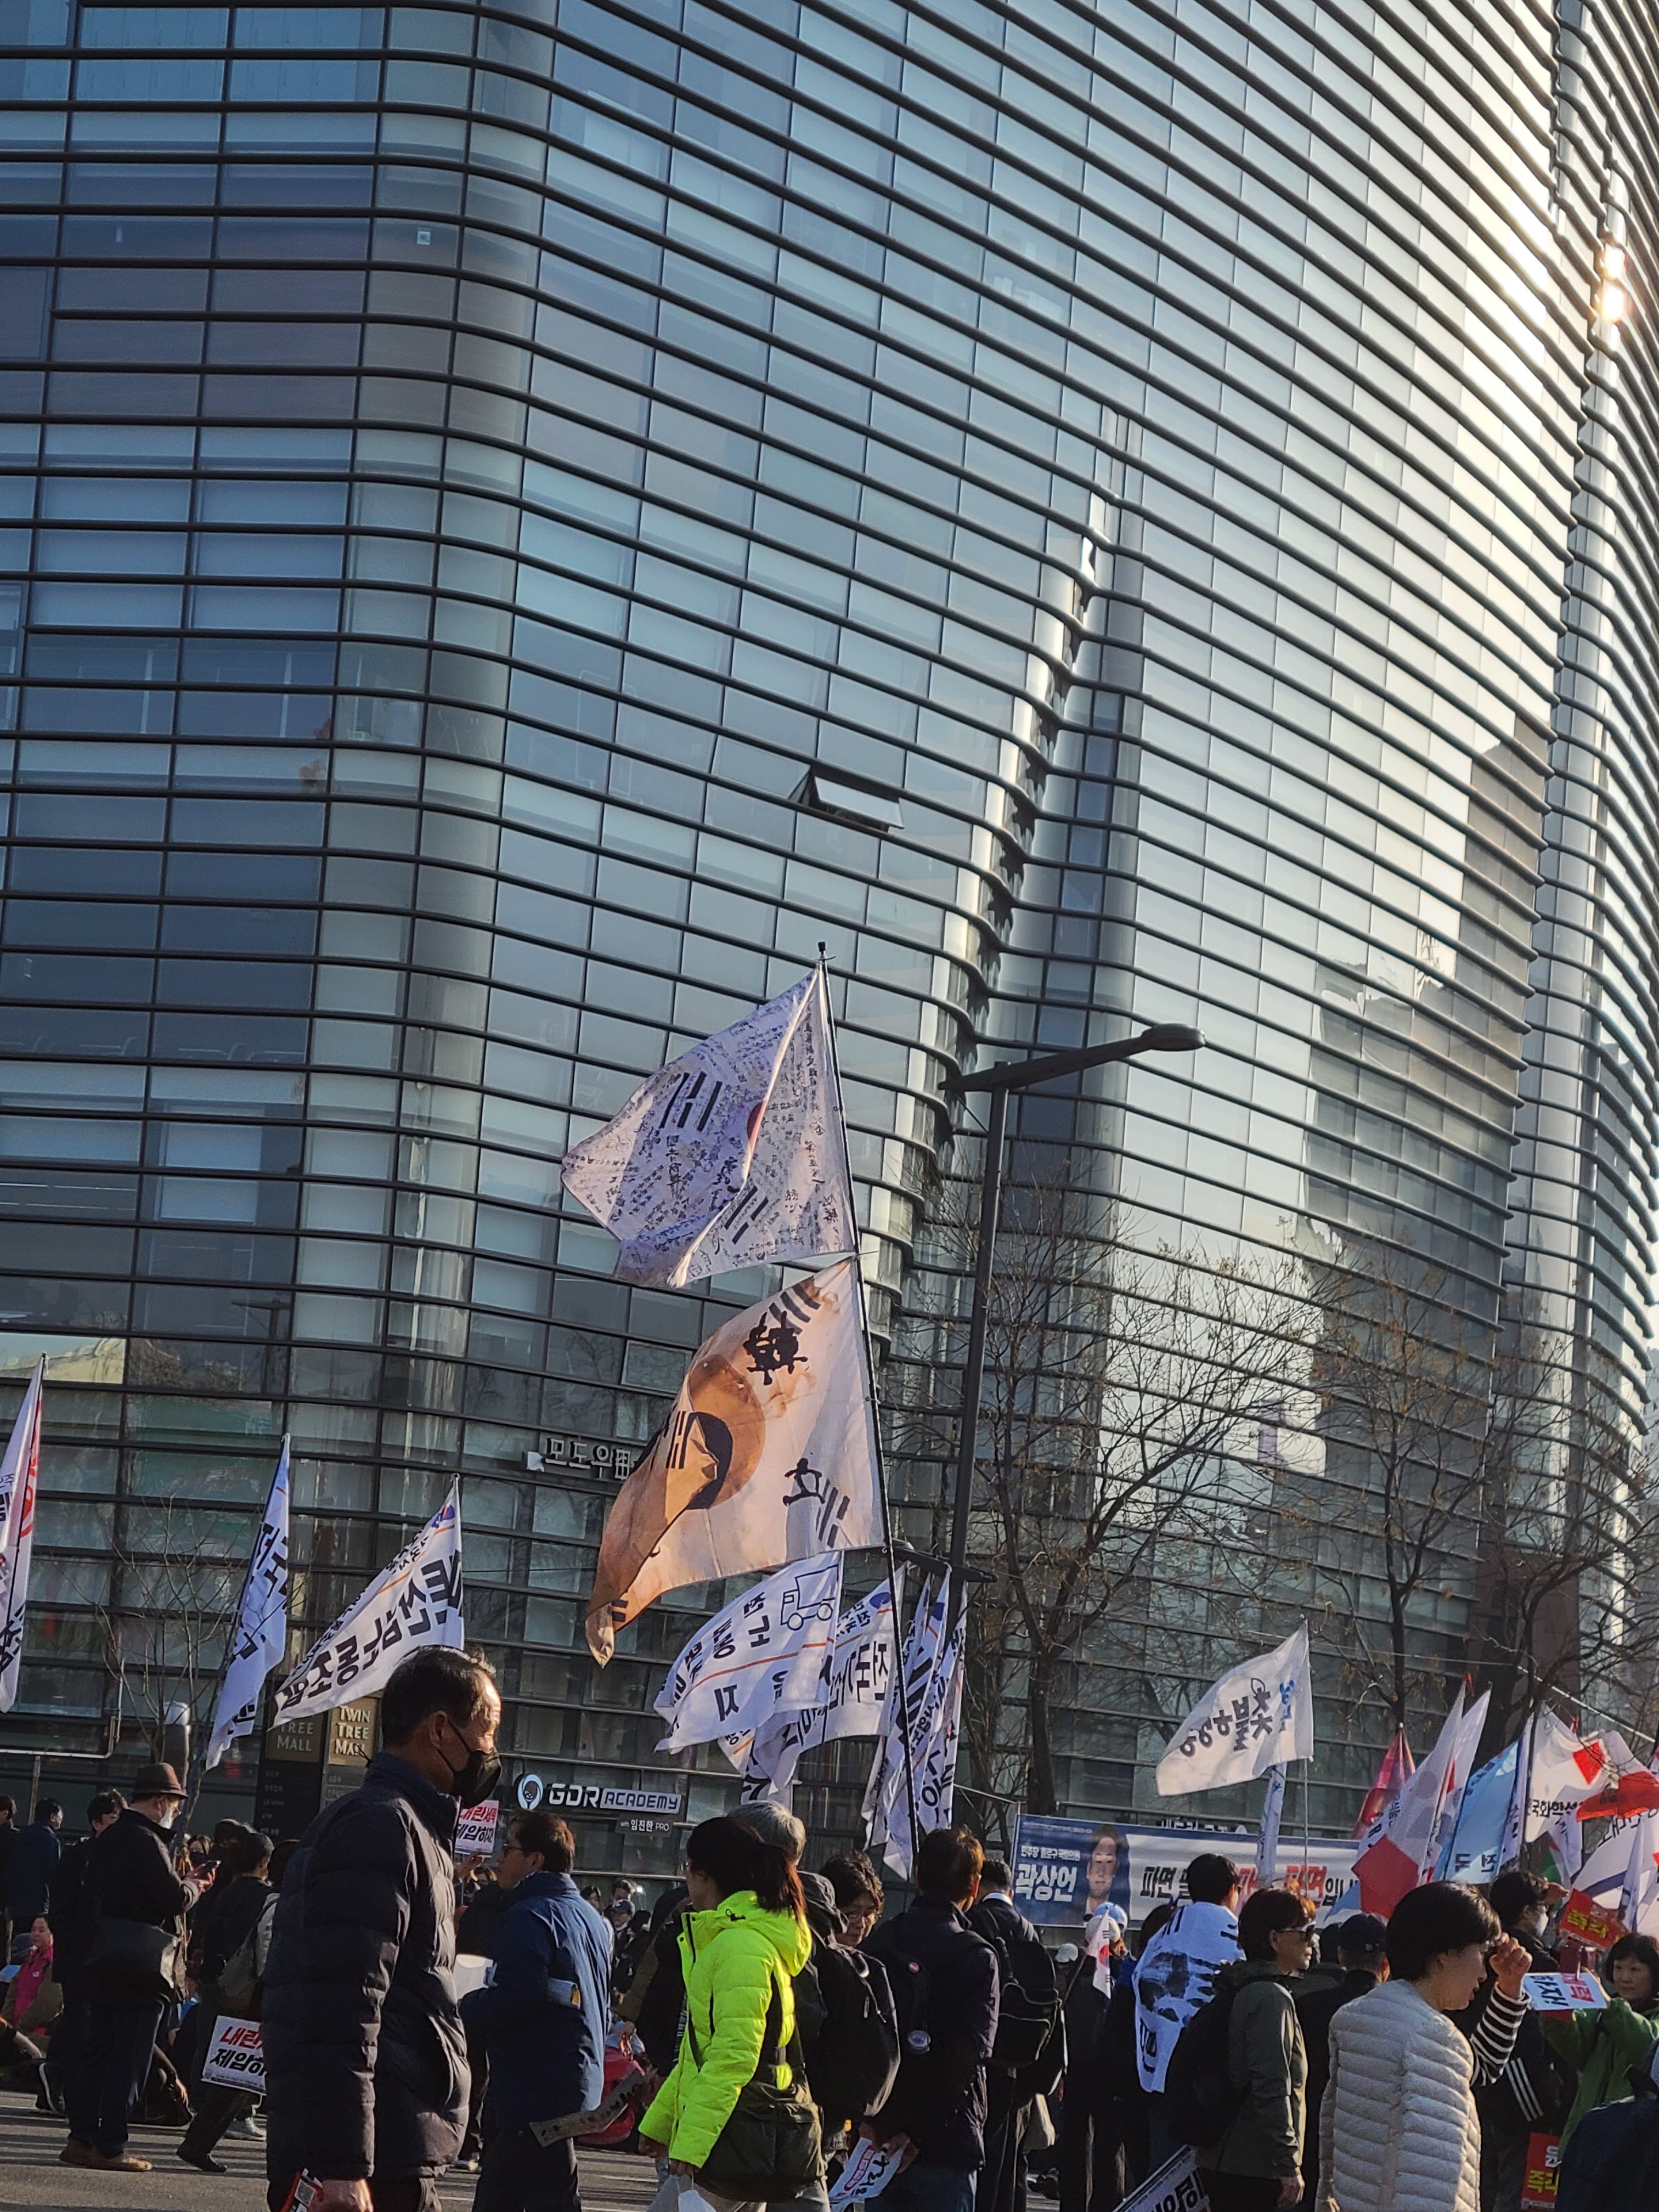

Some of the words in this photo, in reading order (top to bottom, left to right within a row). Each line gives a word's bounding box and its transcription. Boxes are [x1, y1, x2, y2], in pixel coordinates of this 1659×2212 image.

[339, 1706, 370, 1723] TWIN
[337, 1722, 369, 1739] TREE
[277, 1736, 312, 1752] MALL
[549, 1783, 600, 1808] GDR
[604, 1791, 679, 1809] ACADEMY
[630, 1819, 653, 1832] 임진한
[655, 1822, 669, 1831] PRO
[1015, 1864, 1077, 1902] 곽상언
[1140, 1866, 1177, 1898] 파면
